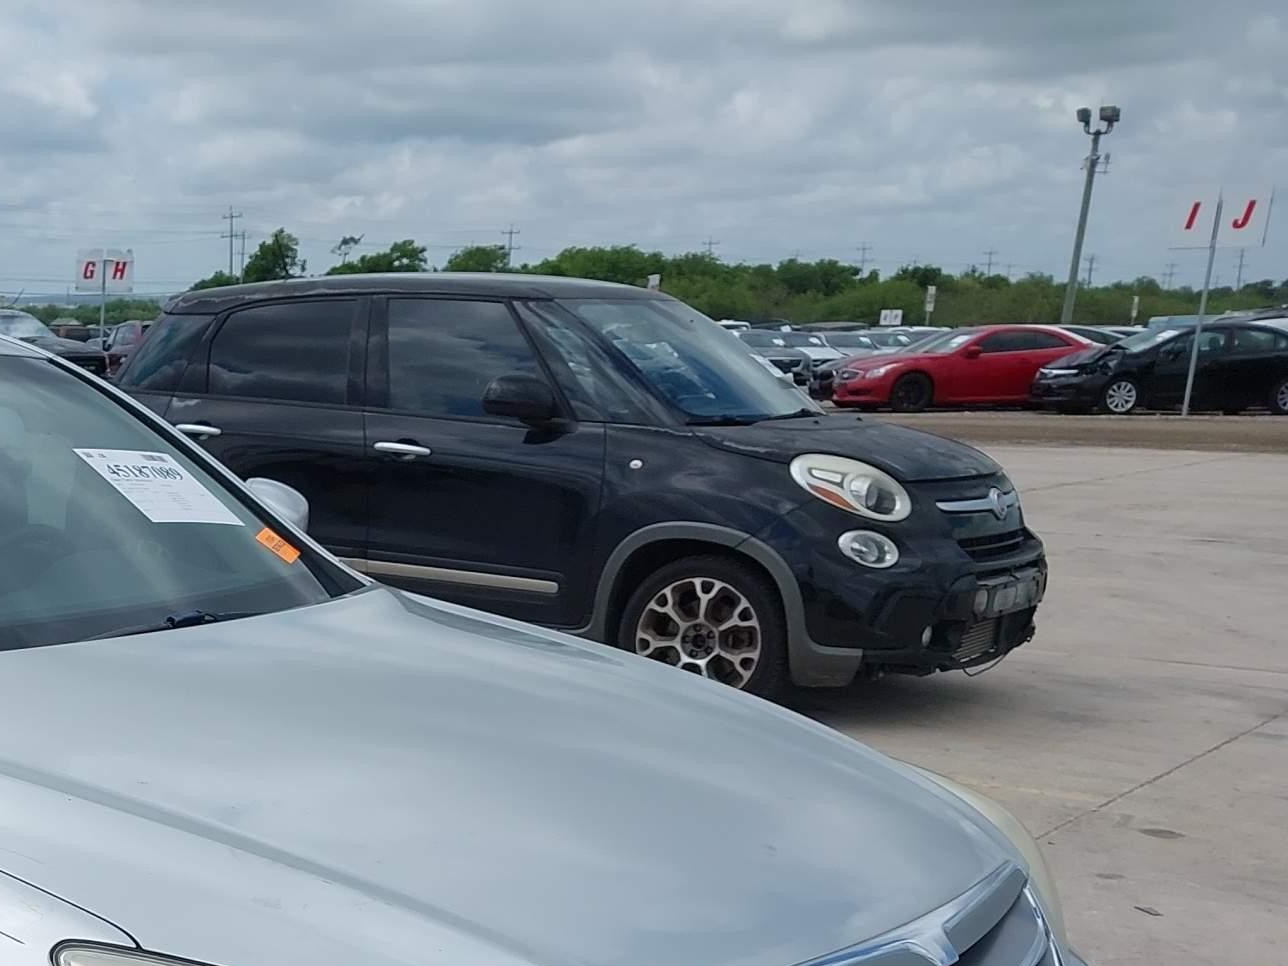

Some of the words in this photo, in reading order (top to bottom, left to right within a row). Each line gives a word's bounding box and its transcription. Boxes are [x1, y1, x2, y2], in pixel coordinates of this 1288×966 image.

[1232, 199, 1257, 229] J
[83, 261, 96, 279] G
[112, 261, 127, 280] H
[107, 464, 184, 481] 45187089
